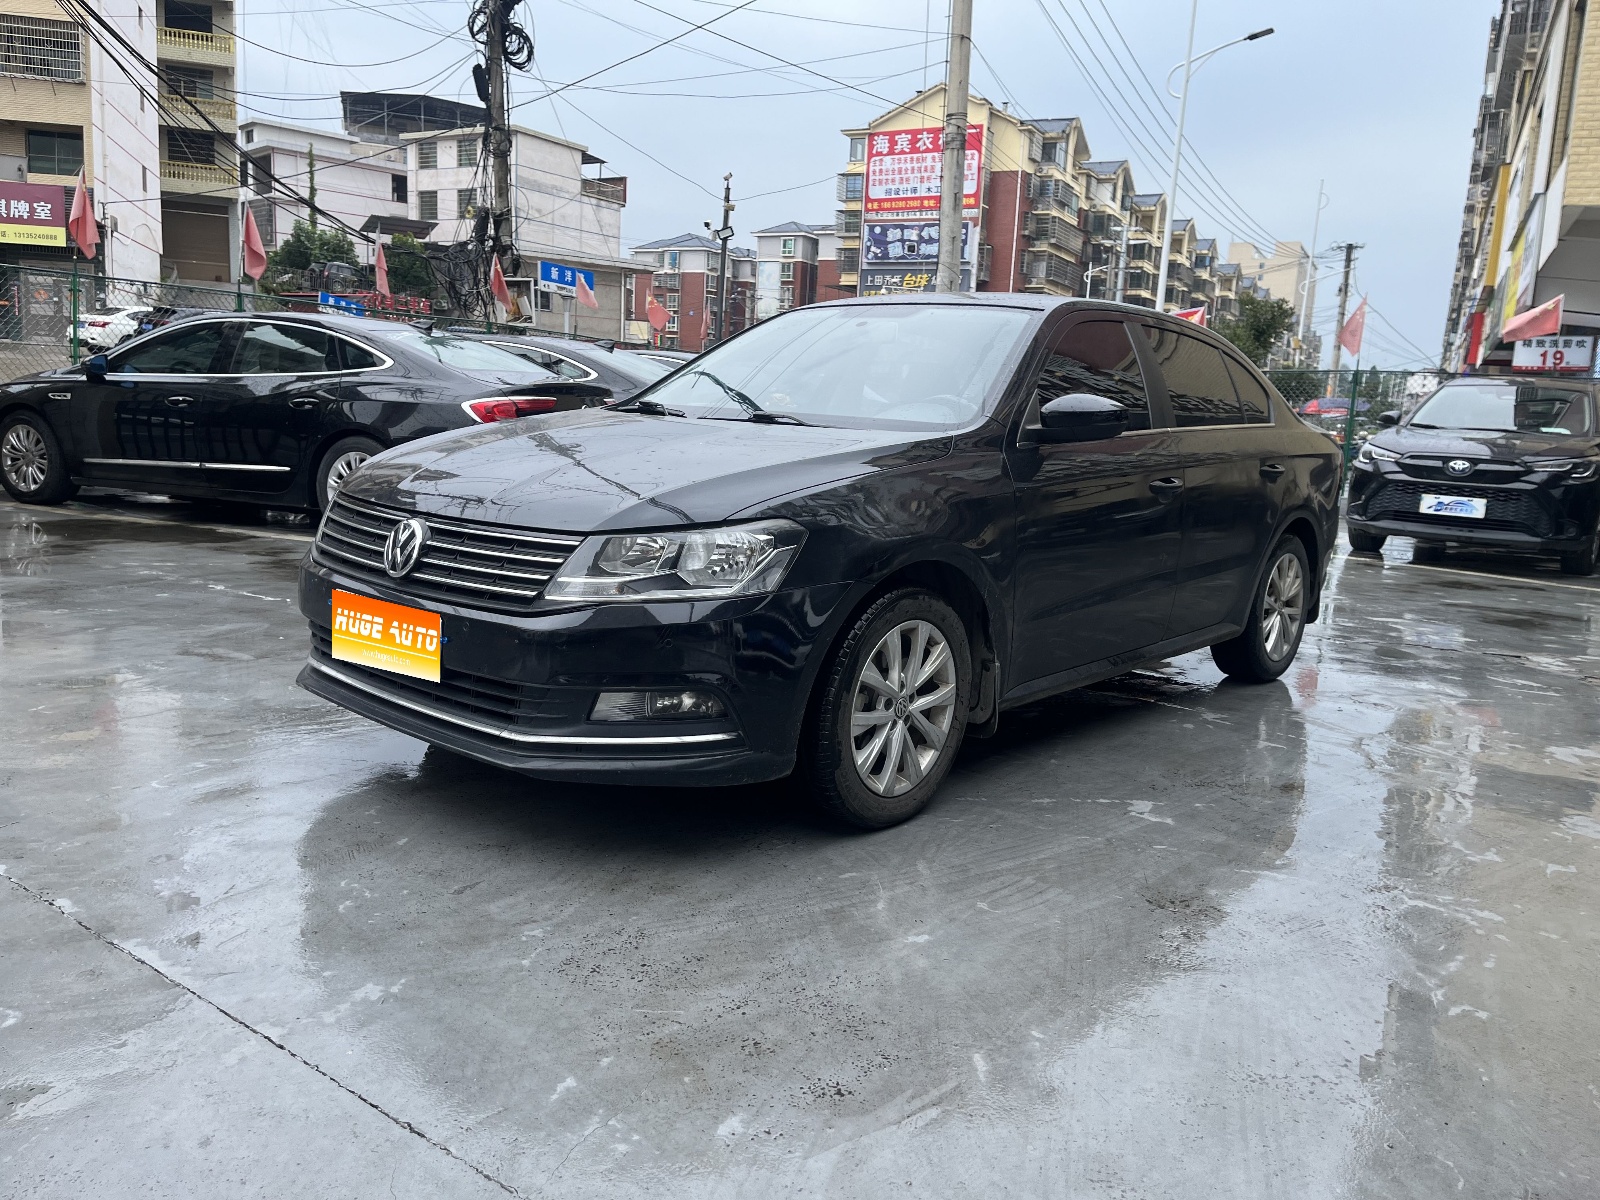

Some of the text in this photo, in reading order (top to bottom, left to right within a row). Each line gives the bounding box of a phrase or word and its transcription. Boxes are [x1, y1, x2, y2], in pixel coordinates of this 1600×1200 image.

[884, 186, 918, 196] 招设计师
[13, 232, 58, 240] 13135240888
[551, 267, 585, 282] 新洋
[1540, 350, 1564, 366] 19
